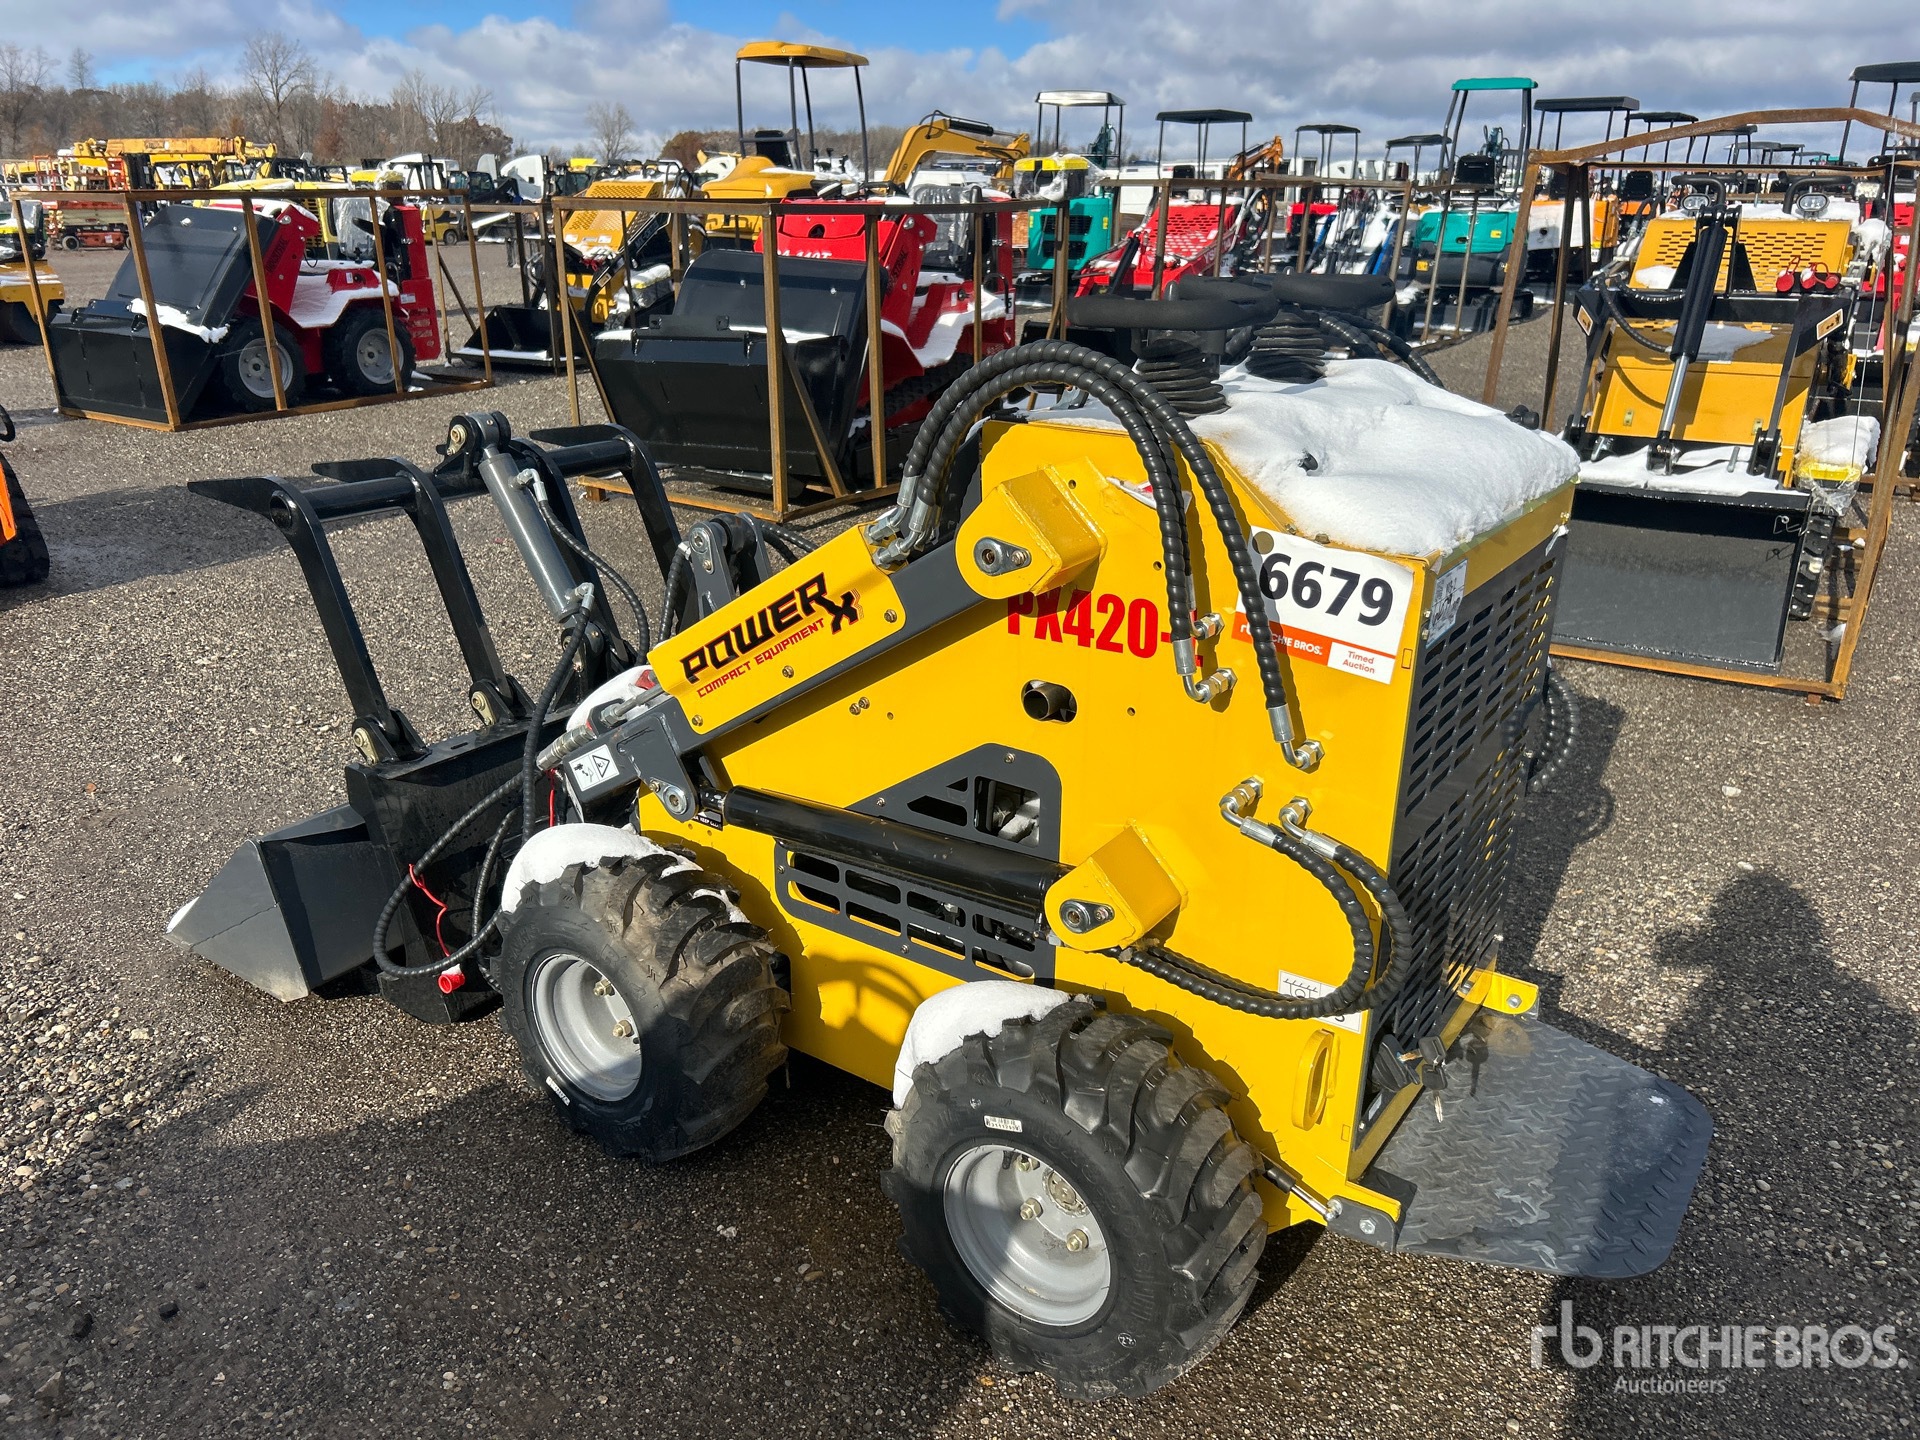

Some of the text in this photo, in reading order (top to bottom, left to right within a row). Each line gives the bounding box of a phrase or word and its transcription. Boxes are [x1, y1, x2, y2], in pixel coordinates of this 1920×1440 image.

[1259, 552, 1394, 627] 6679
[696, 617, 826, 699] COMPACT EQUIPMENT
[1342, 659, 1376, 674] Auction
[1347, 650, 1375, 665] Timed
